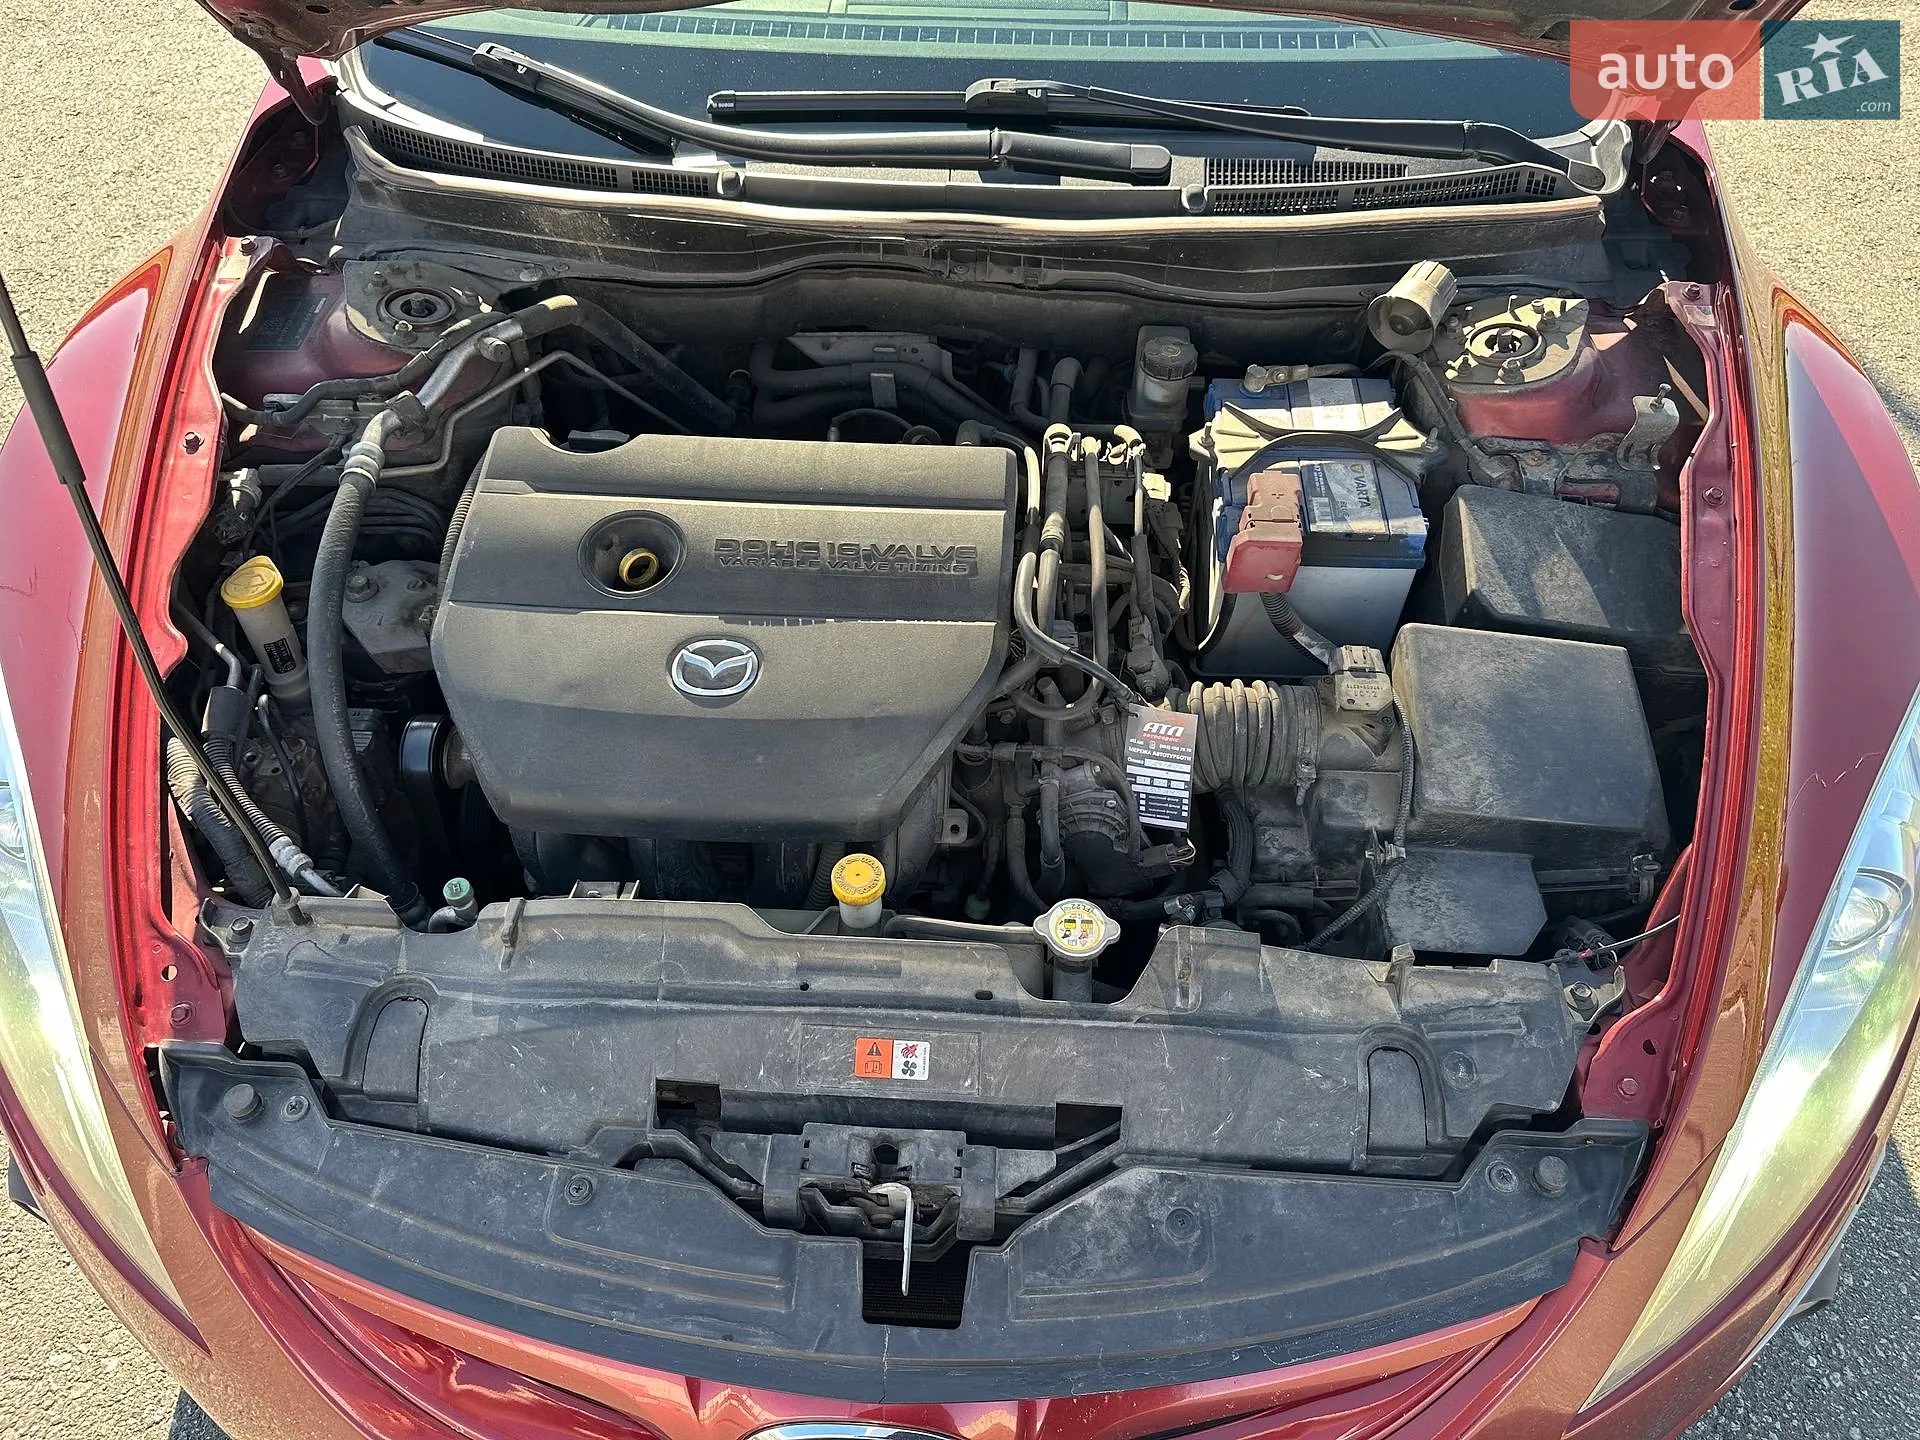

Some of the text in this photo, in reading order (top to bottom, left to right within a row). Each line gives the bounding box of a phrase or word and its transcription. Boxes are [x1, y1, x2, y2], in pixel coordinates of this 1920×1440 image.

[1355, 475, 1371, 509] VARTA
[713, 538, 820, 558] DOHC
[719, 556, 970, 574] VARIABLE VALVE TIMING
